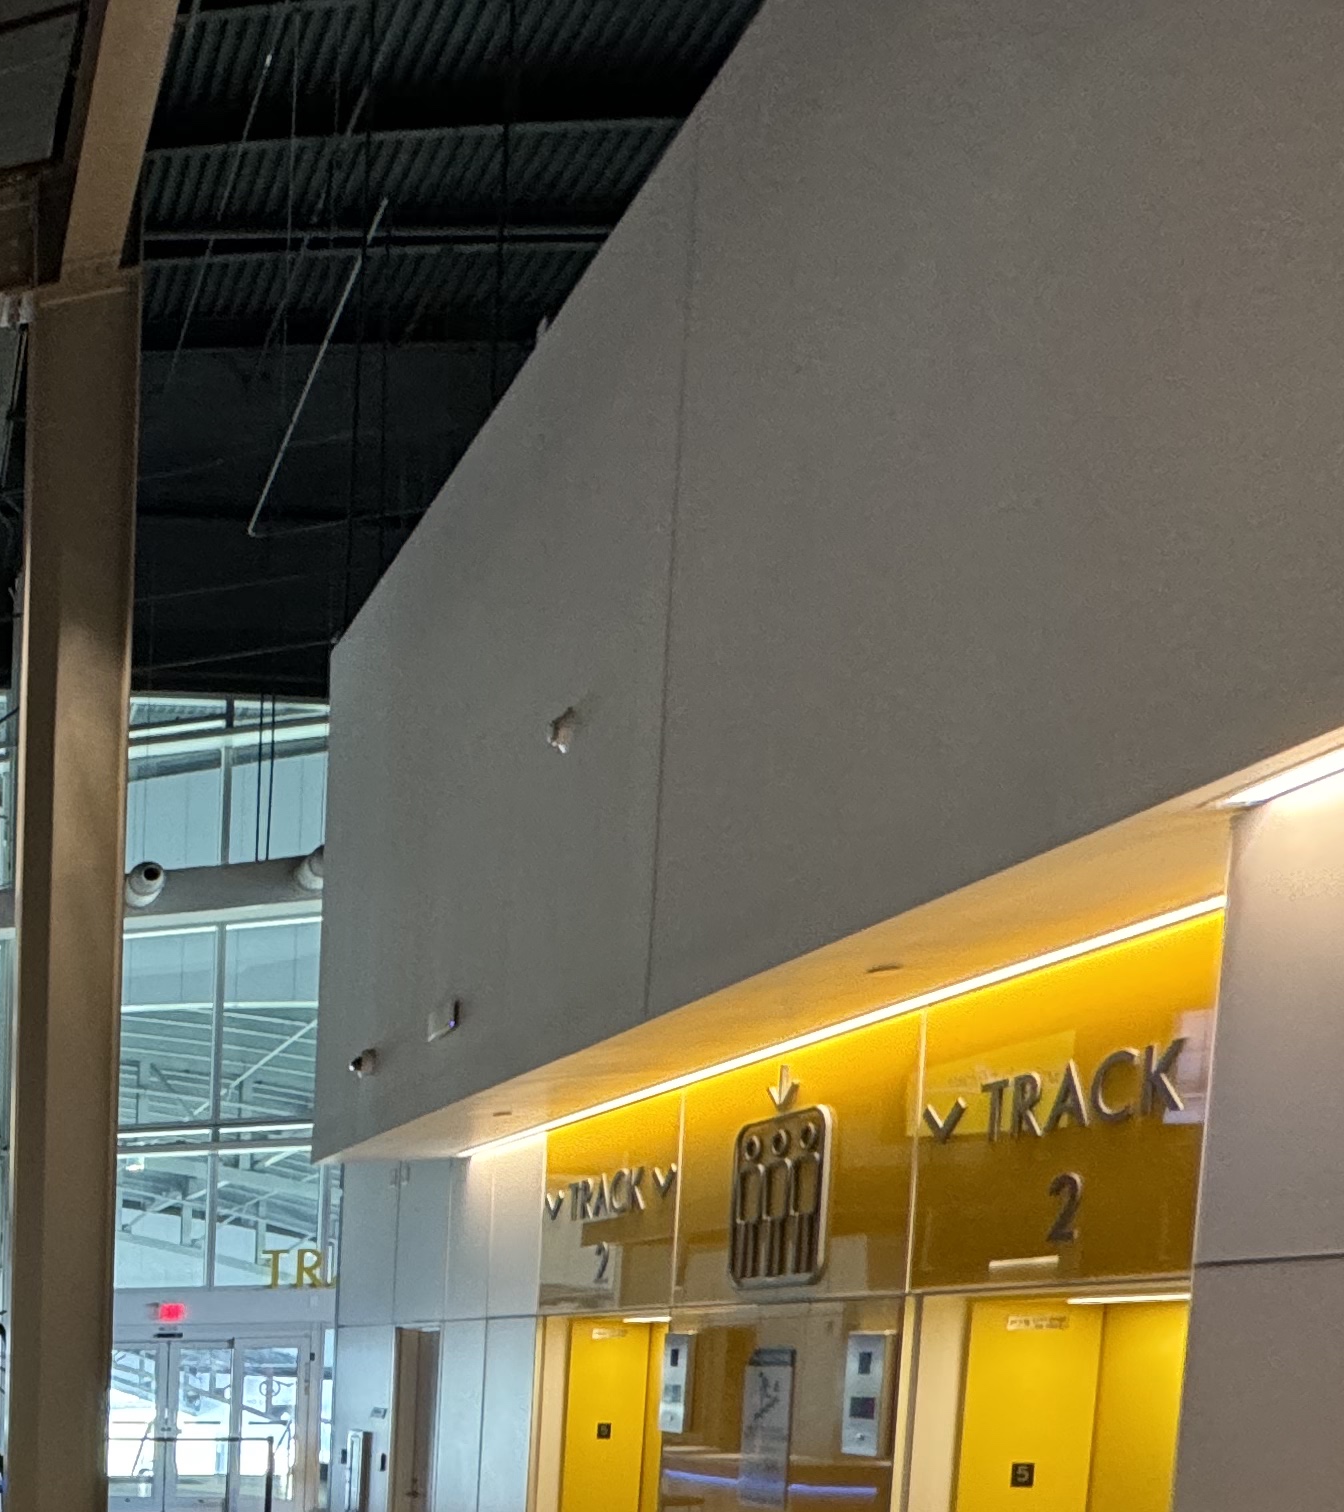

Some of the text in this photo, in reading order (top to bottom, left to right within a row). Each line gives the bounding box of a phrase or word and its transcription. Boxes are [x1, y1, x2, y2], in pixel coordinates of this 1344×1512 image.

[981, 1036, 1189, 1142] TRACK
[568, 1166, 646, 1221] TRACK
[1046, 1171, 1084, 1244] 2
[594, 1241, 610, 1284] 2
[1015, 1465, 1030, 1483] 5
